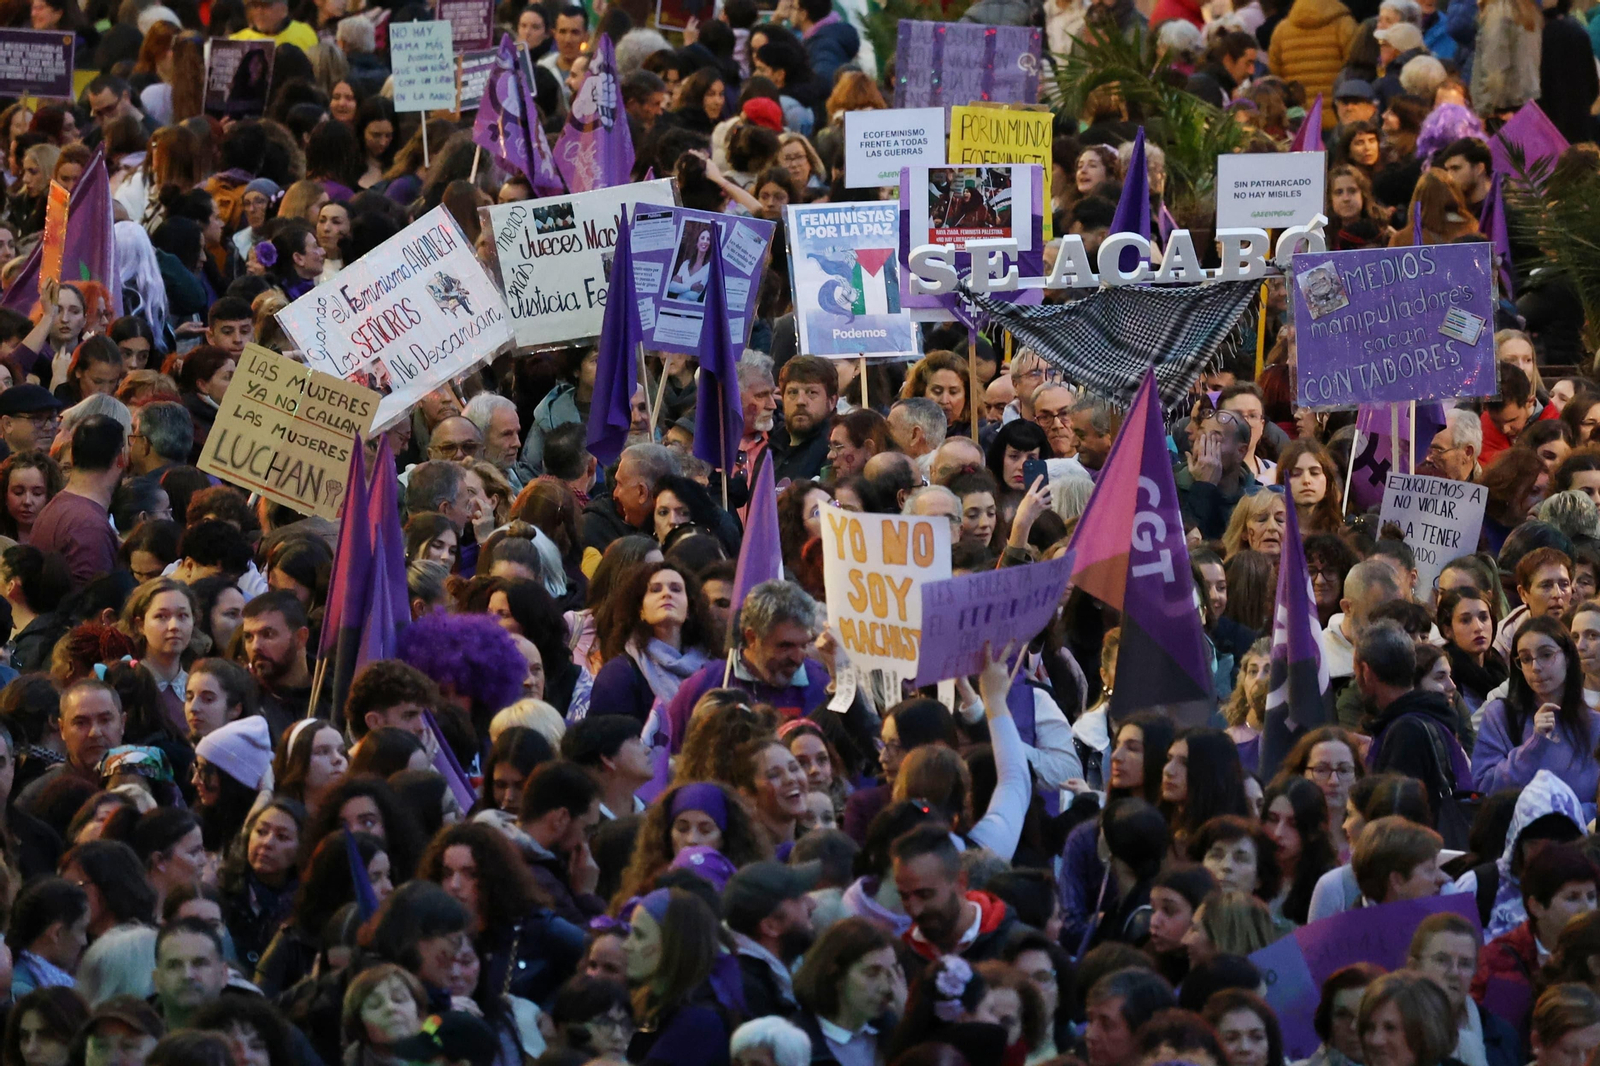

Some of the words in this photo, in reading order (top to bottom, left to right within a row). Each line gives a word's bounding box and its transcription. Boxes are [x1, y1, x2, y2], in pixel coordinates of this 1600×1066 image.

[392, 27, 407, 38] NO
[413, 26, 433, 37] HAY
[413, 93, 424, 101] LA
[860, 140, 891, 149] FRENTE
[893, 139, 899, 147] A
[901, 137, 928, 146] TODAS
[863, 128, 925, 139] ECOFEMINISMO
[961, 113, 990, 143] POR
[990, 117, 1006, 146] UN
[1007, 118, 1052, 149] MUNDO
[866, 149, 882, 158] LAS
[884, 147, 923, 157] GUERRAS
[877, 170, 901, 179] GREEN
[1234, 181, 1248, 189] SIN
[1250, 178, 1312, 188] PATRIARCADO
[1248, 191, 1267, 199] HAY
[1268, 189, 1302, 198] MISILES
[801, 209, 895, 227] FEMINISTAS
[805, 225, 838, 239] POR
[840, 224, 861, 238] LA
[863, 222, 893, 236] PAZ
[908, 237, 1019, 296] SE
[1044, 213, 1329, 287] ACABÓ
[331, 294, 351, 325] el
[401, 224, 458, 275] AVANZA
[1343, 248, 1436, 295] MEDIOS
[1311, 285, 1474, 339] manipuladores
[351, 297, 422, 360] SEÑOROS
[832, 328, 887, 340] Podemos
[1363, 326, 1427, 354] sacan
[247, 355, 280, 382] LAS
[286, 375, 370, 417] MUJERES
[1304, 339, 1461, 403] CONTADORES
[246, 380, 268, 402] YA
[275, 394, 297, 412] NO
[306, 406, 362, 435] CALLAN
[233, 404, 263, 428] LAS
[271, 423, 349, 462] MUJERES
[212, 428, 325, 502] LUCHAN
[1388, 475, 1466, 500] EDUQUEMOS
[1469, 487, 1481, 504] A
[1393, 494, 1412, 510] NO
[1418, 497, 1458, 520] VIOLAR.
[828, 513, 868, 564] YO
[881, 519, 935, 568] NO
[1131, 475, 1175, 583] CGT
[1405, 521, 1414, 539] A
[1421, 522, 1461, 549] TENER
[847, 568, 913, 622] SOY
[839, 616, 922, 662] MACHIST
